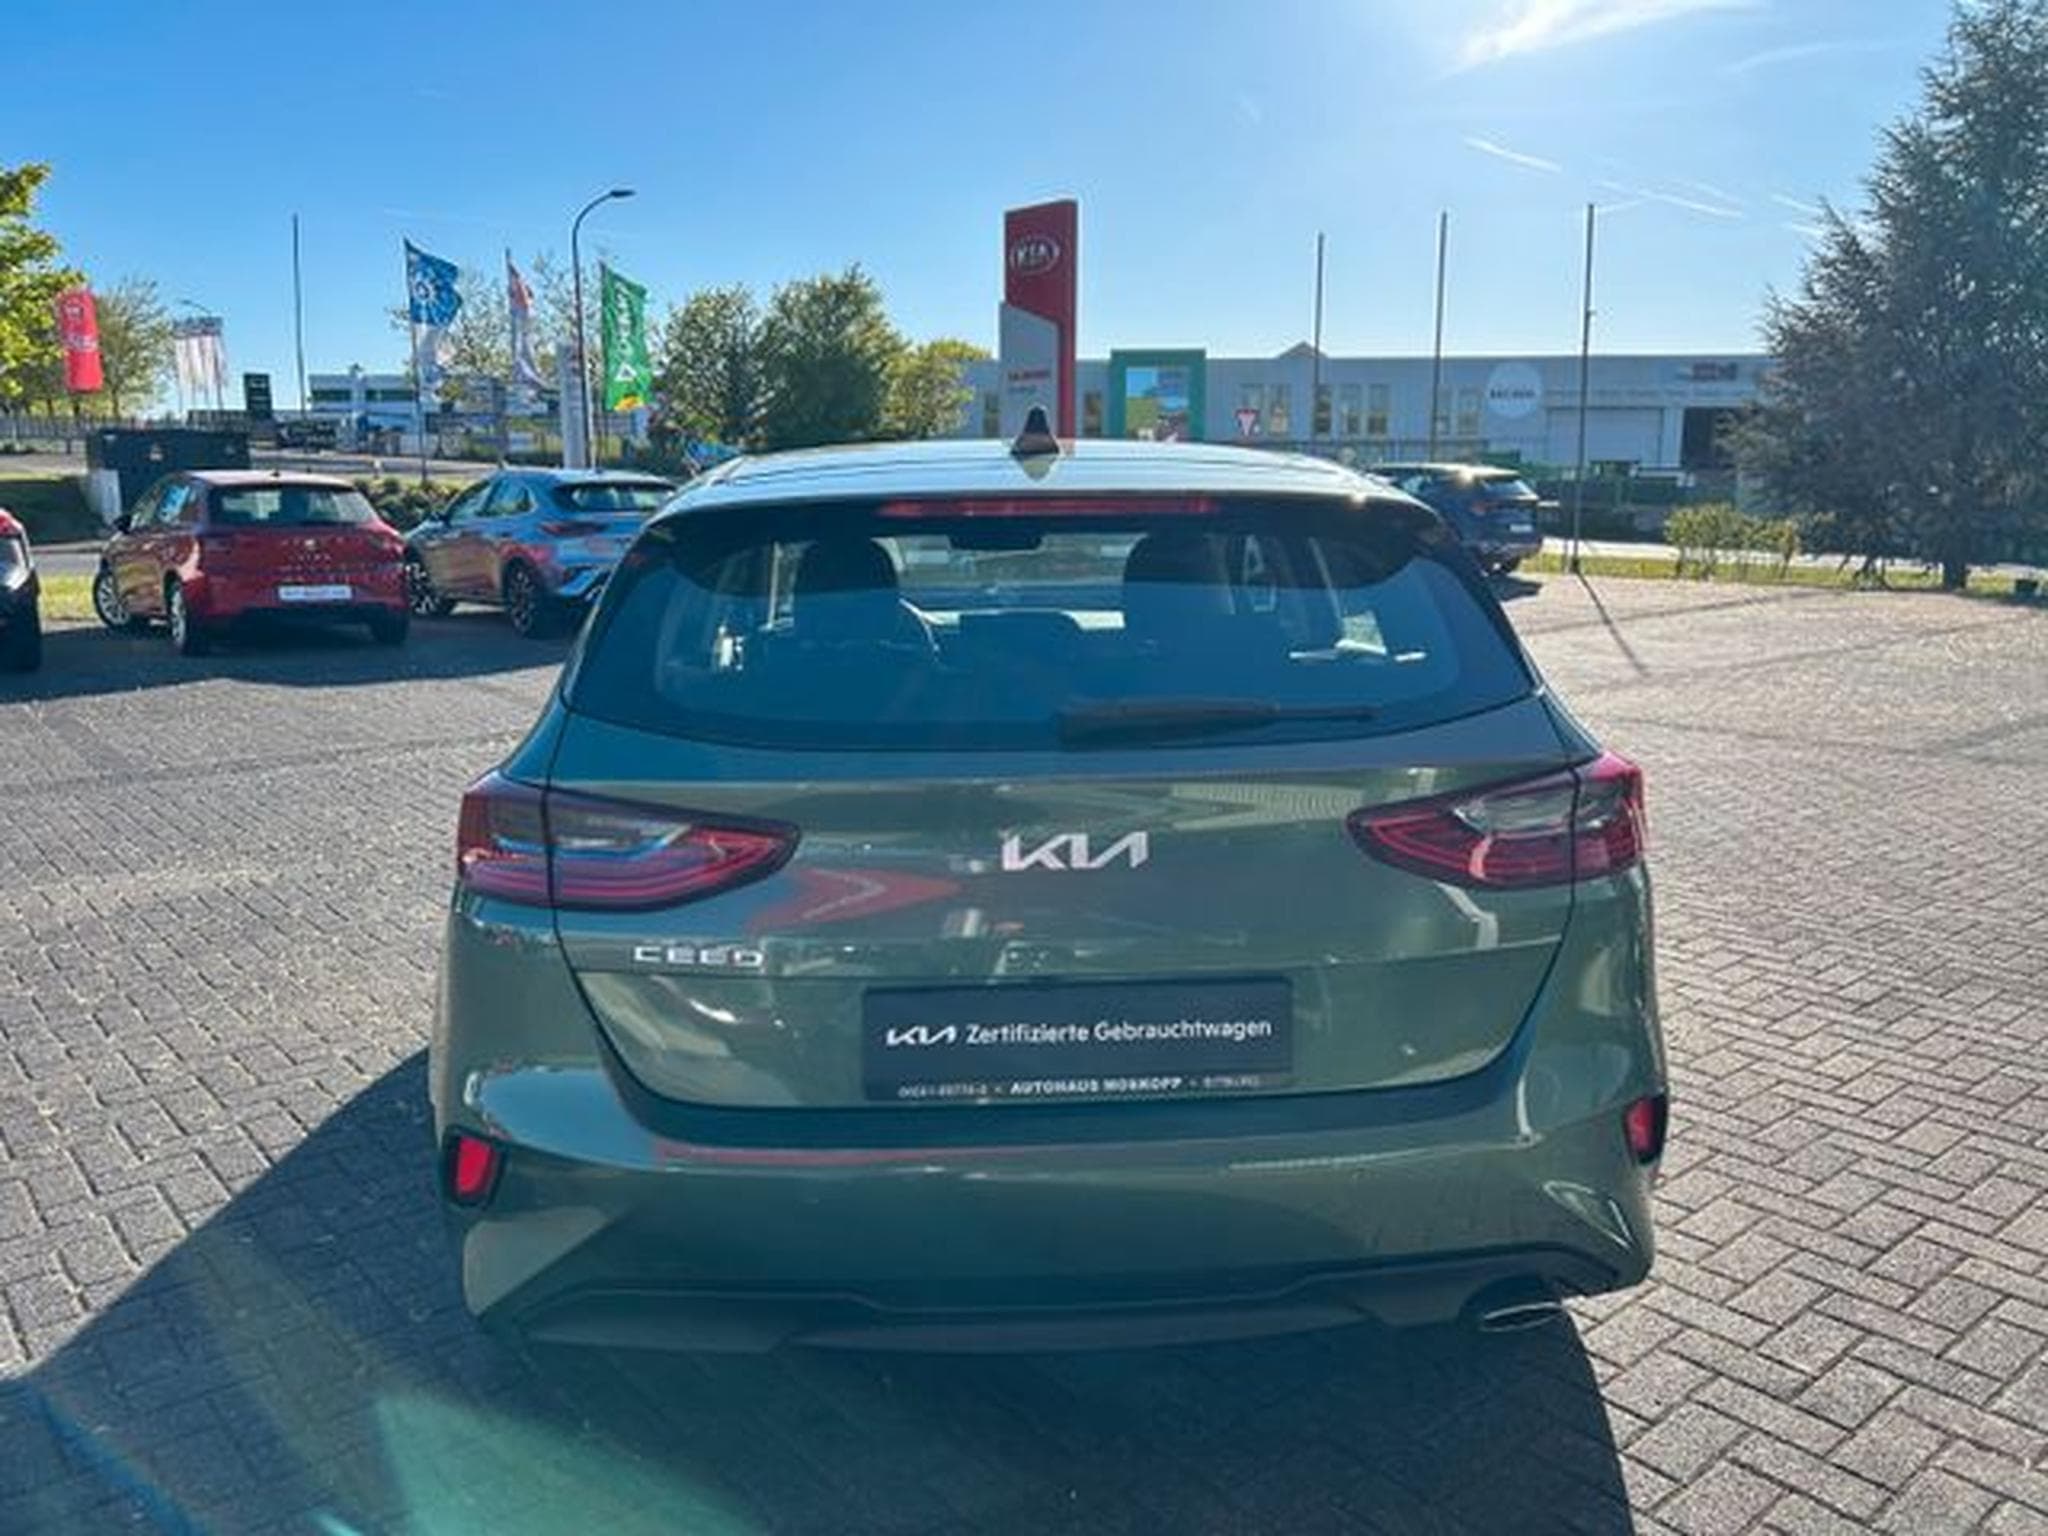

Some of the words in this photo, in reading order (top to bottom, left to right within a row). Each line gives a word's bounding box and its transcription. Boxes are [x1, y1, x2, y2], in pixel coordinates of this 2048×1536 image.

[1002, 831, 1148, 871] KIA
[634, 945, 763, 968] CEED
[886, 1025, 957, 1046] KIA
[966, 1023, 1089, 1044] Zertifizierte
[1095, 1019, 1272, 1042] Gebrauchtwagen
[1010, 1078, 1099, 1095] AUTOHAUS
